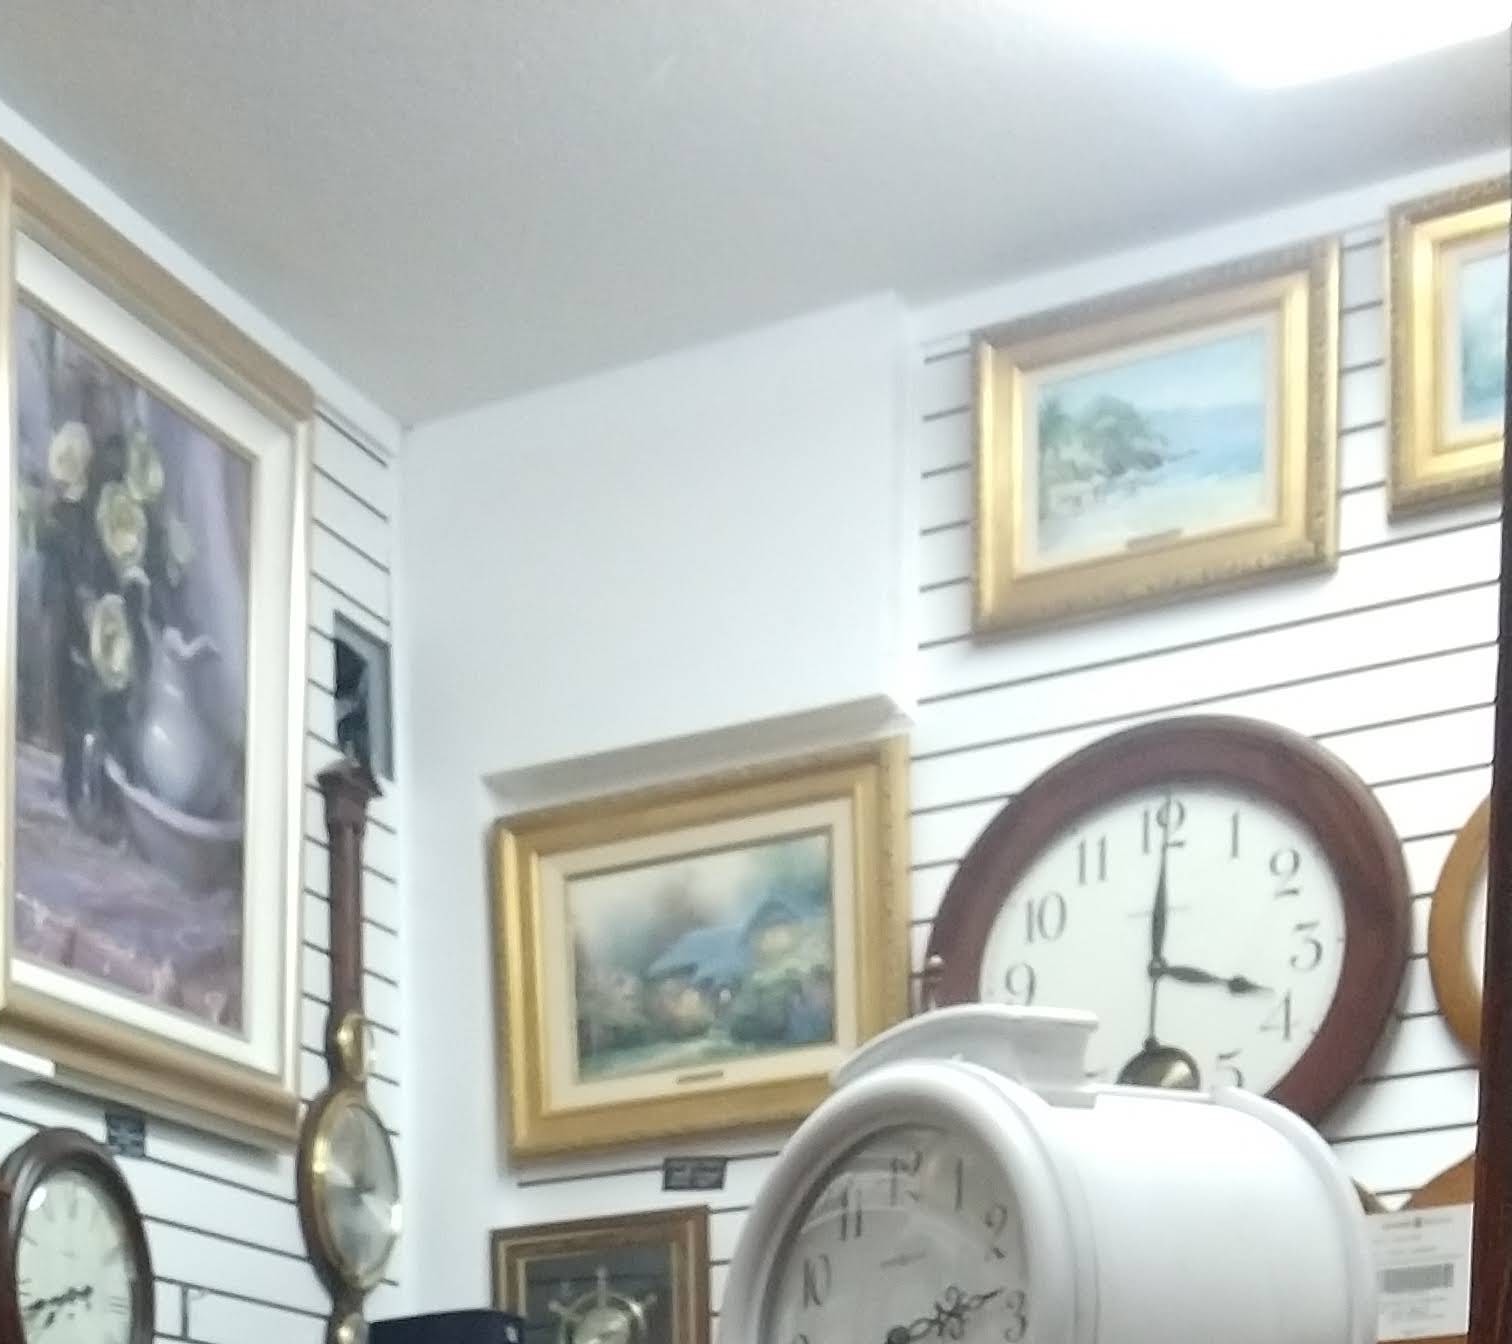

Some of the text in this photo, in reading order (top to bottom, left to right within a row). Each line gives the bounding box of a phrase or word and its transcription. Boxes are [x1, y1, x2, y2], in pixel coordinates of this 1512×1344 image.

[1140, 798, 1187, 855] 12
[1227, 811, 1242, 860] 1
[1075, 836, 1108, 885] 11
[1268, 848, 1303, 898] 2
[1024, 892, 1068, 943] 10
[1289, 923, 1324, 972] 3
[1004, 962, 1038, 1004] 9
[1259, 991, 1295, 1042] 4
[1217, 1050, 1245, 1090] 5
[889, 1147, 925, 1207] 12
[953, 1157, 965, 1211] 1
[838, 1180, 864, 1241] 11
[984, 1205, 1009, 1260] 2
[803, 1254, 832, 1307] 10
[1004, 1291, 1030, 1344] 3
